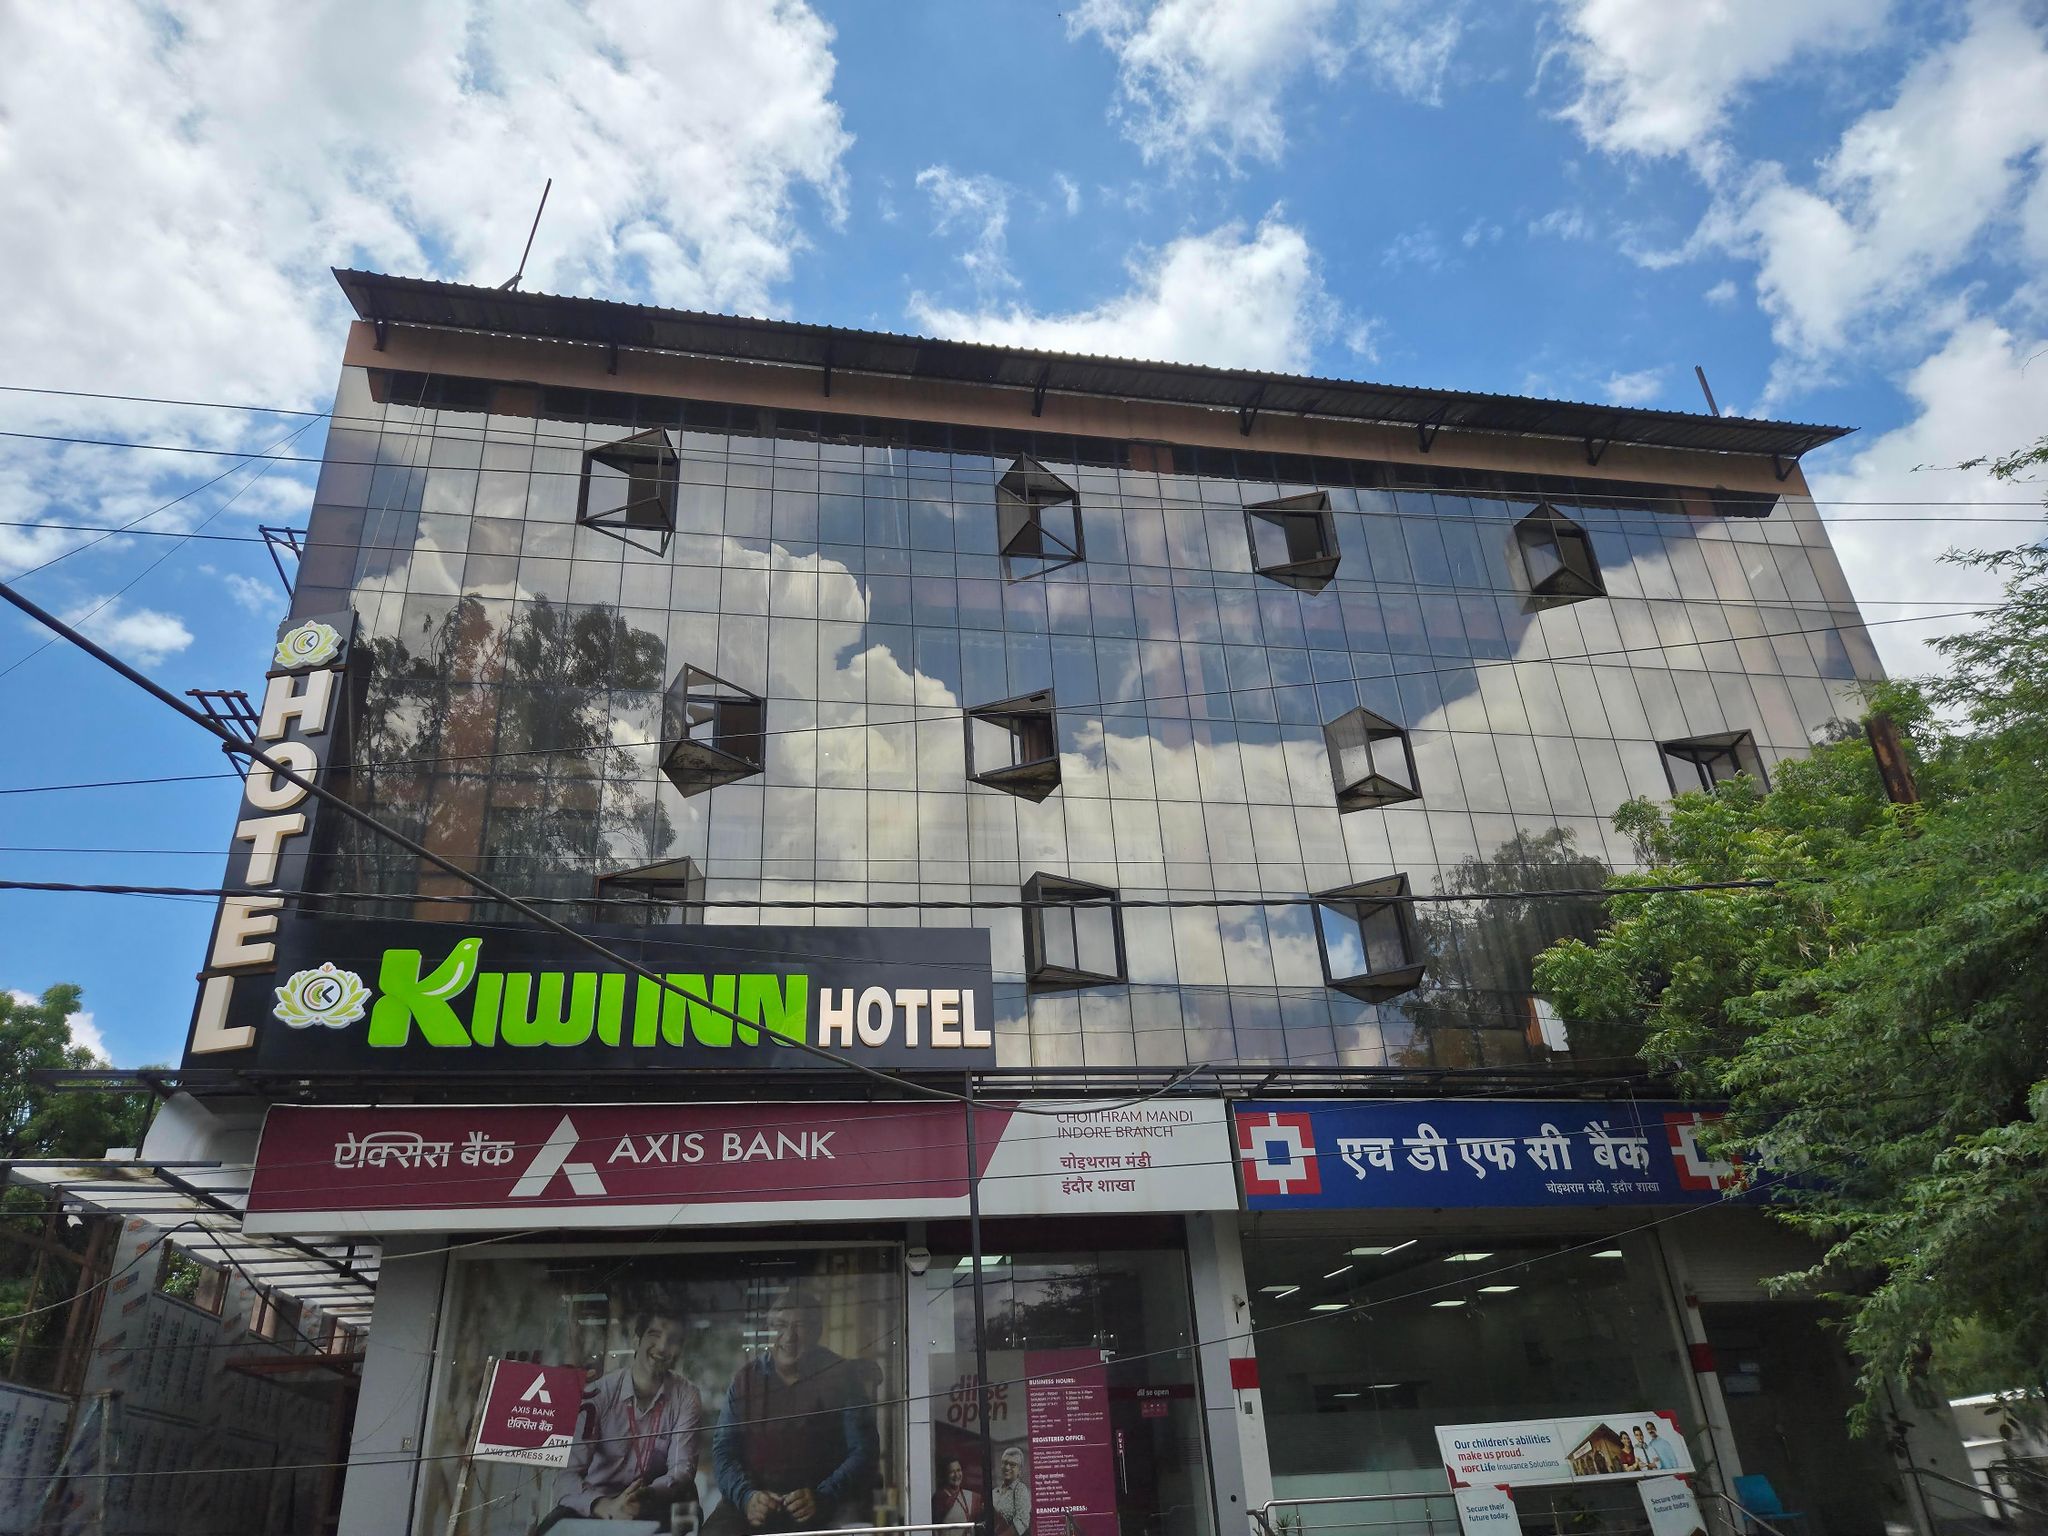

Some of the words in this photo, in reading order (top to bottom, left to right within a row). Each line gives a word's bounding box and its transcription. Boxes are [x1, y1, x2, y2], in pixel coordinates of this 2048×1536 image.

[191, 669, 336, 1054] HOTEL
[633, 974, 808, 1048] INN
[818, 987, 992, 1048] HOTEL
[1056, 1111, 1142, 1123] CHOITHRAM
[1146, 1110, 1193, 1123] MANDI
[1058, 1126, 1112, 1139] INDORE
[1116, 1126, 1173, 1138] BRANCH
[460, 1131, 515, 1167] बैंक
[607, 1133, 704, 1164] AXIS
[722, 1131, 836, 1162] BANK
[1337, 1137, 1394, 1180] एच
[1402, 1123, 1448, 1171] डी
[1456, 1137, 1516, 1180] एफ
[1524, 1123, 1572, 1171] सी
[1584, 1120, 1650, 1171] बैंक
[1060, 1152, 1121, 1170] चोइथराम
[1125, 1151, 1151, 1169] मंडी
[1061, 1176, 1093, 1194] इंदौर
[1098, 1179, 1136, 1193] शाखा
[1544, 1180, 1585, 1193] चोइथराम
[1611, 1179, 1632, 1192] इंदौर
[1635, 1182, 1660, 1193] शाखा
[511, 1405, 531, 1415] AXIS
[532, 1407, 556, 1417] BANK
[548, 1437, 569, 1448] ATM
[1454, 1440, 1471, 1450] Our
[1472, 1436, 1514, 1448] children's
[1515, 1434, 1551, 1445] abilities
[504, 1450, 543, 1461] EXPRESS
[545, 1453, 563, 1462] 24x7
[1458, 1450, 1482, 1461] make
[1483, 1450, 1494, 1459] us
[1495, 1447, 1525, 1460] proud.
[1497, 1461, 1529, 1471] Insurance
[1529, 1459, 1560, 1469] Solutions
[1651, 1496, 1670, 1504] Secure
[1671, 1493, 1685, 1501] their
[1466, 1504, 1488, 1512] Secure
[1489, 1502, 1505, 1511] their
[1653, 1504, 1672, 1513] future
[1468, 1512, 1490, 1521] future
